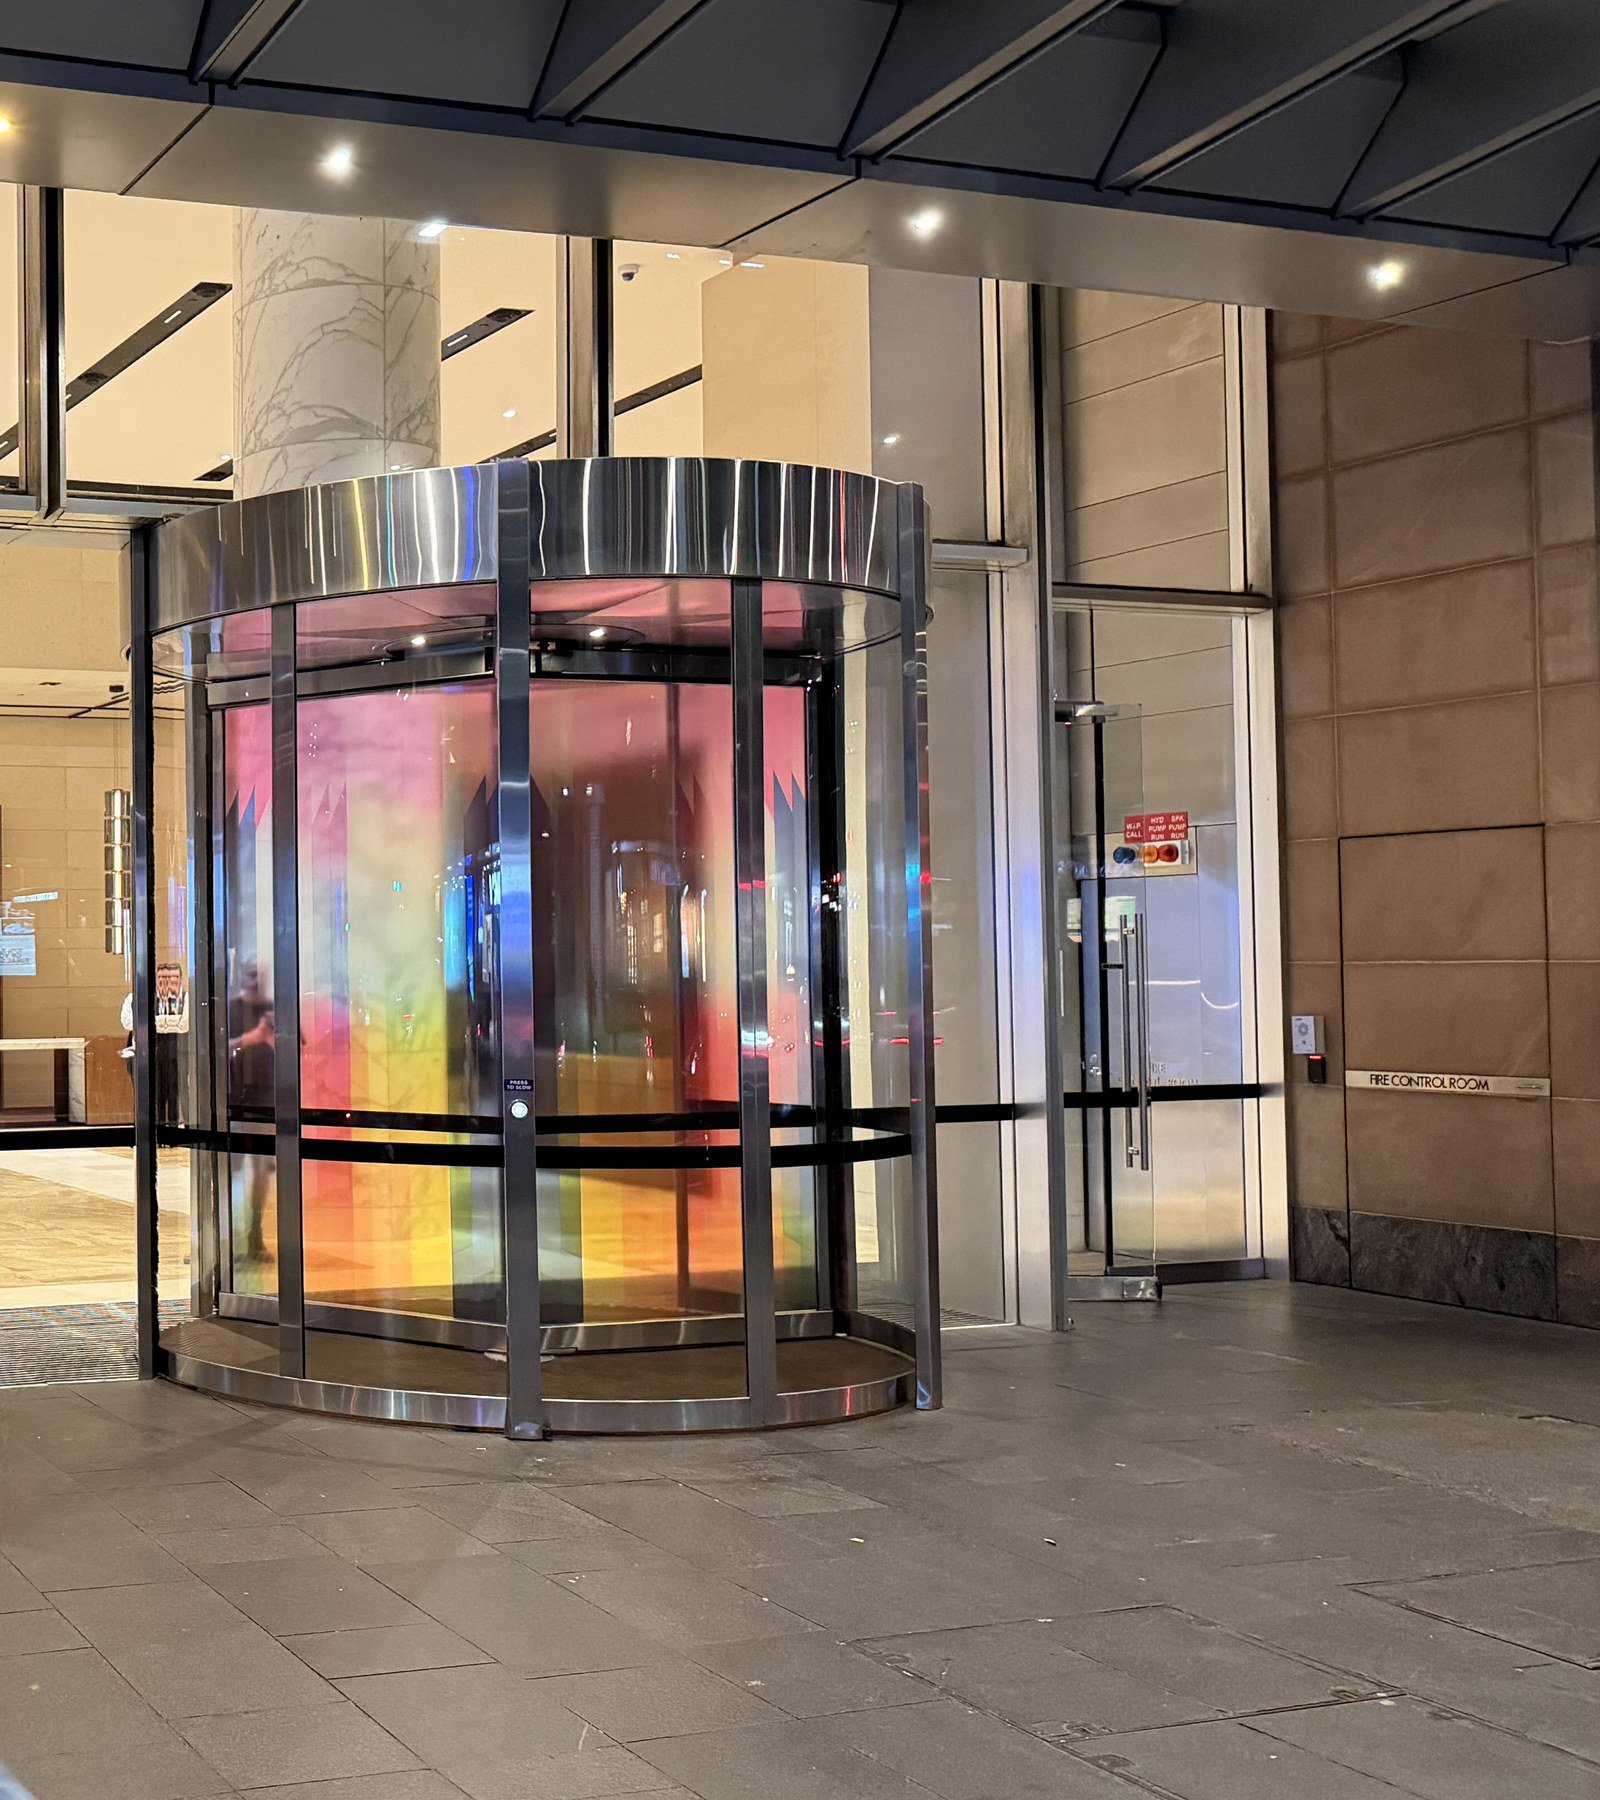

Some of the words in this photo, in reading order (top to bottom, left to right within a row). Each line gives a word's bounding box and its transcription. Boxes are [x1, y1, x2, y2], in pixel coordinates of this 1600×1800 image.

[1151, 816, 1165, 824] HYD
[1171, 814, 1185, 822] SPK
[1148, 824, 1167, 832] PUMP
[1168, 823, 1186, 831] PUMP
[1369, 1073, 1390, 1086] FIRE
[1390, 1074, 1448, 1089] CONTROL
[1448, 1077, 1490, 1091] ROOM
